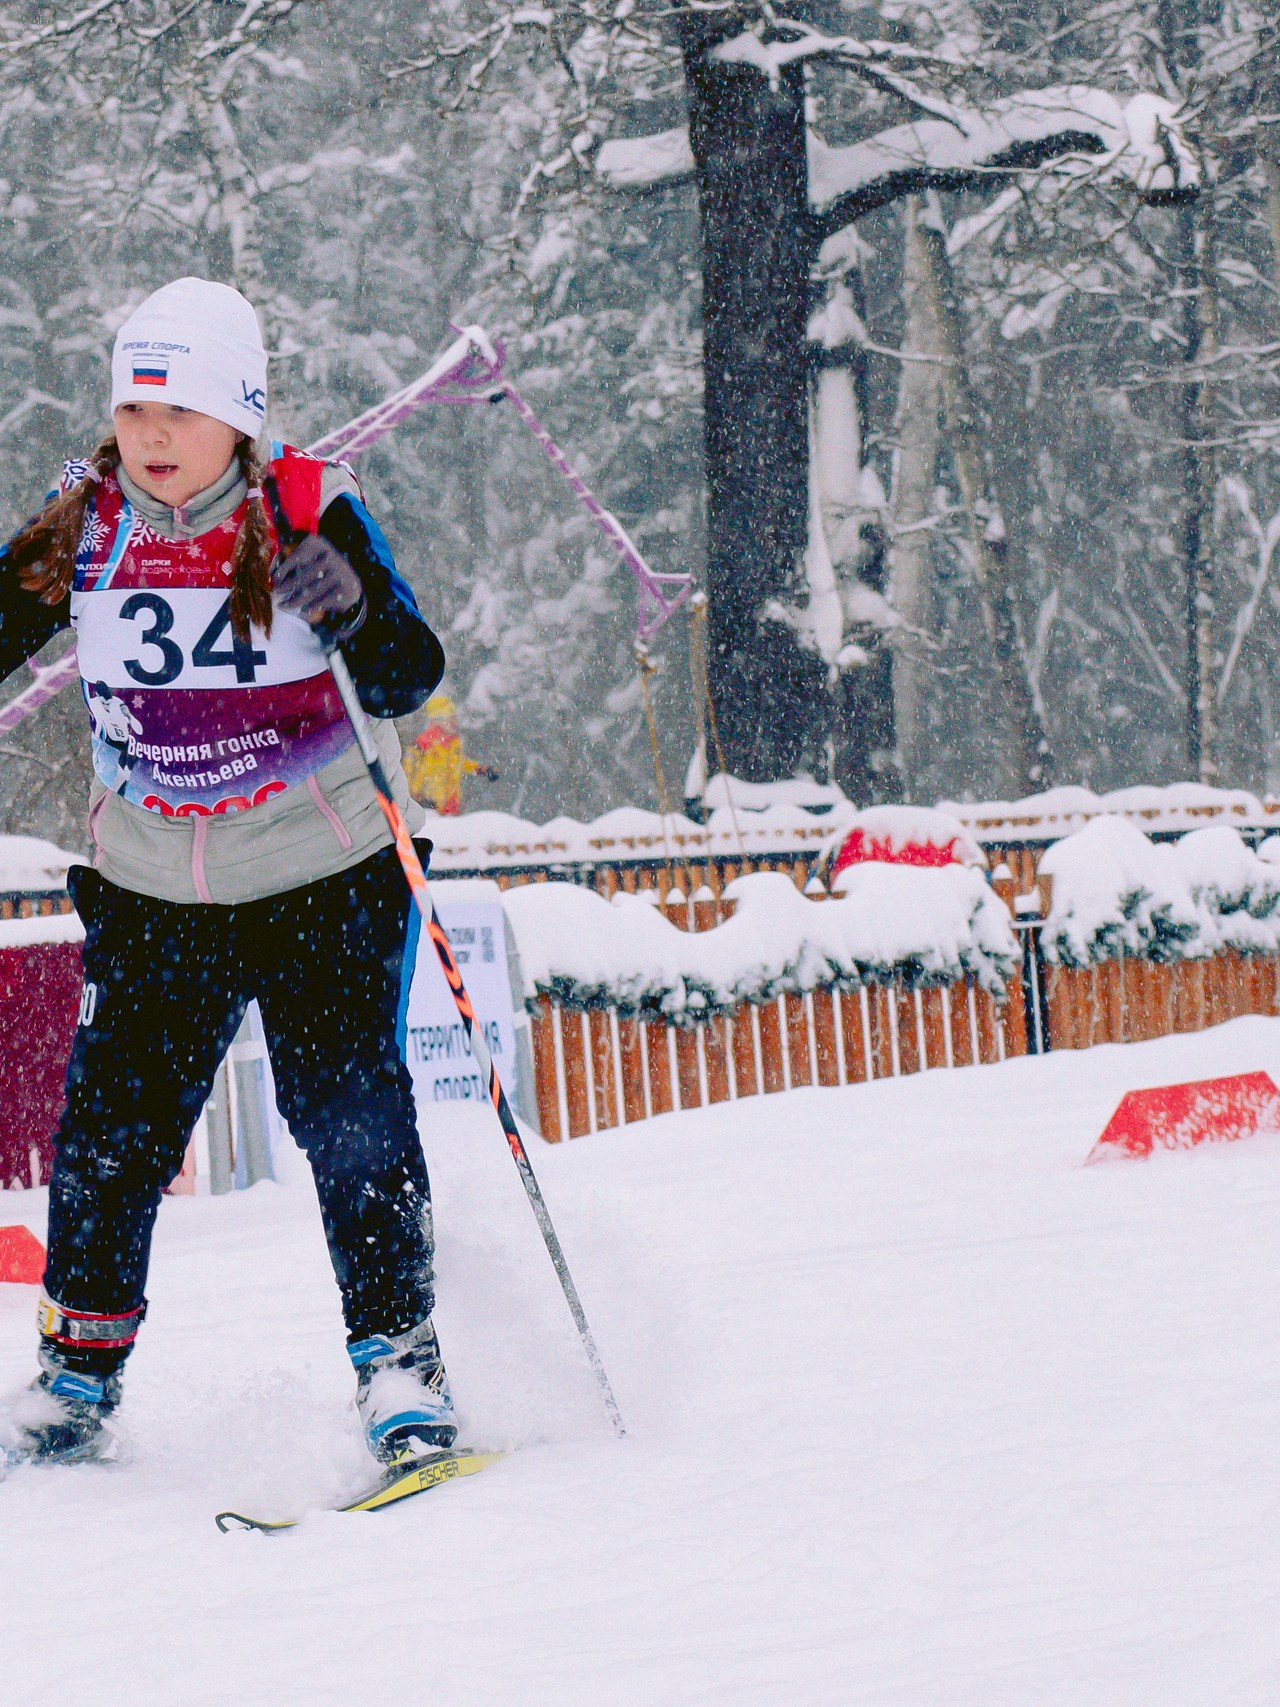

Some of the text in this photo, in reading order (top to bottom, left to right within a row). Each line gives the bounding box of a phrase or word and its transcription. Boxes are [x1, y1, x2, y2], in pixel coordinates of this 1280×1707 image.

[150, 341, 191, 354] СПОРТА
[141, 559, 172, 567] ПАРКИ
[118, 592, 268, 687] 34
[127, 728, 280, 765] Вечерняя гонка
[152, 752, 258, 788] Акентьева
[410, 1021, 503, 1063] ТЕРРИТОИЯ
[417, 1460, 461, 1488] FISCHER
